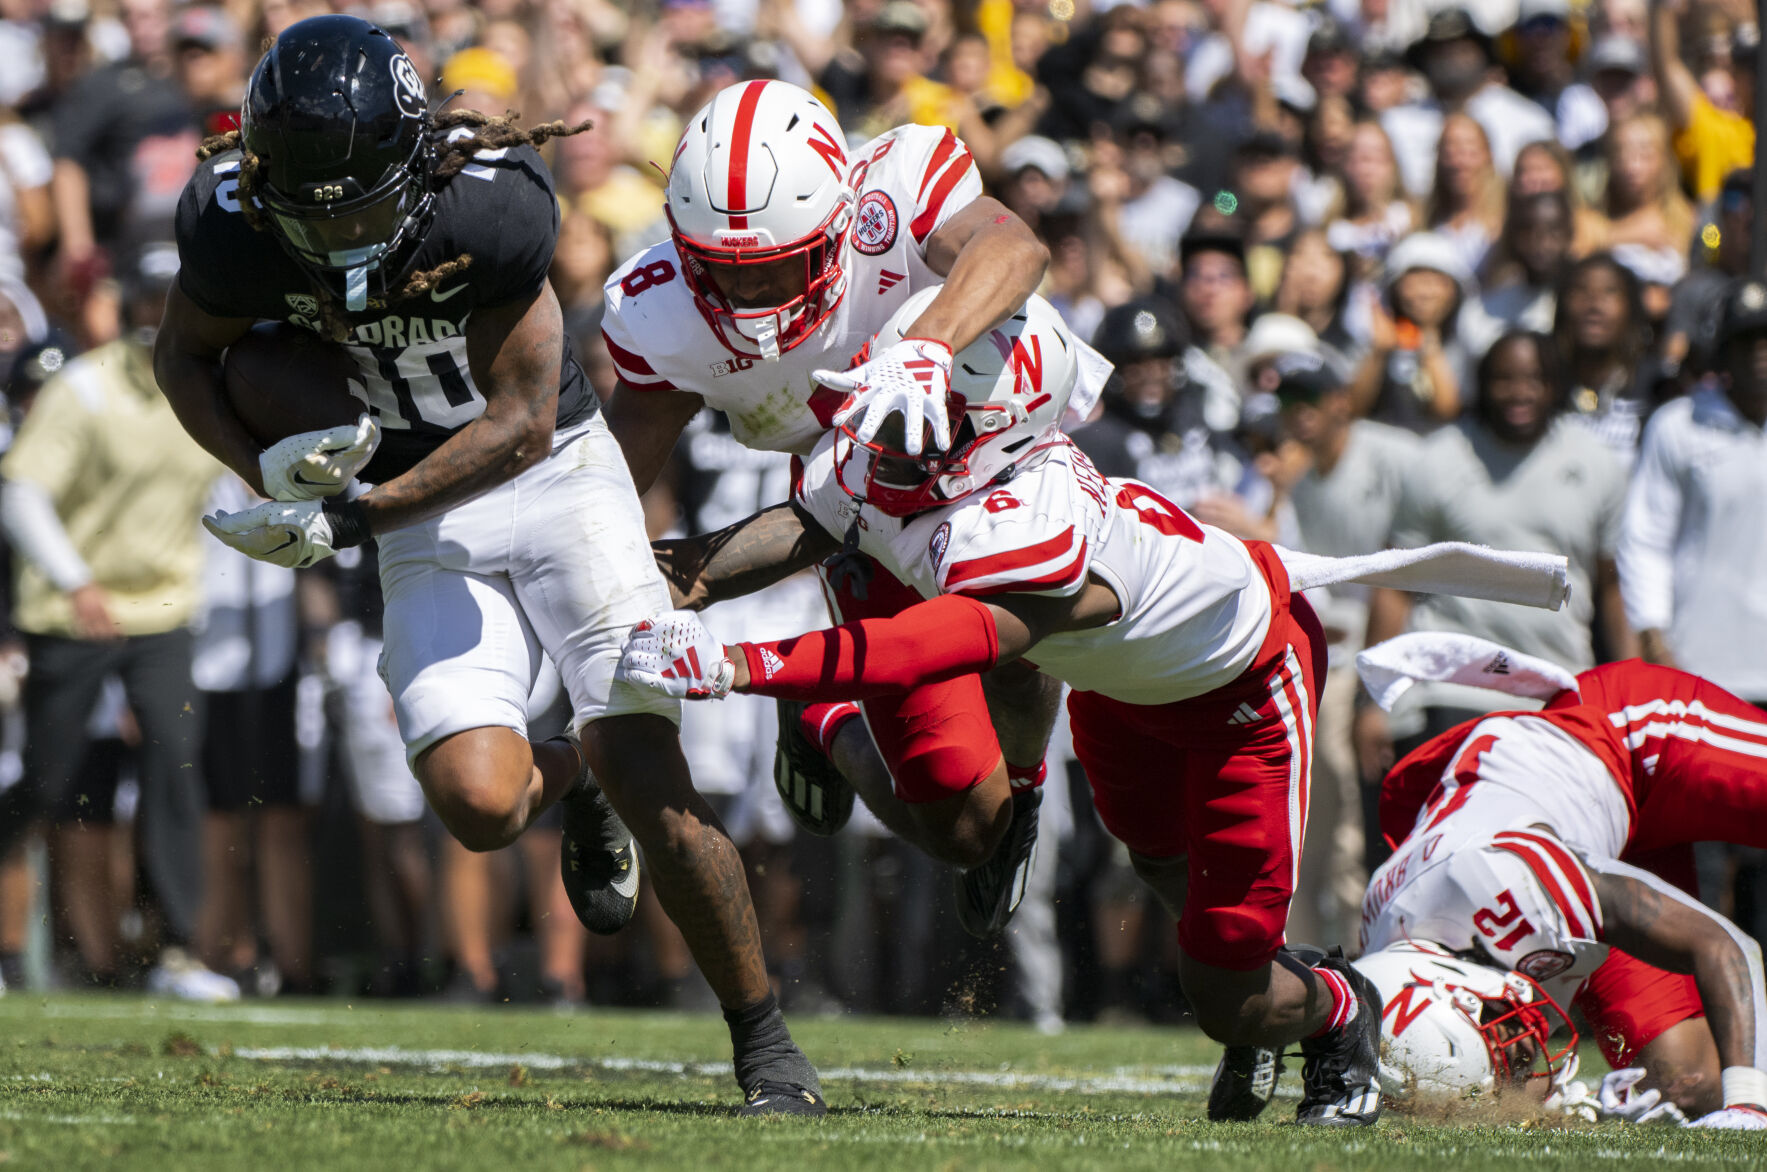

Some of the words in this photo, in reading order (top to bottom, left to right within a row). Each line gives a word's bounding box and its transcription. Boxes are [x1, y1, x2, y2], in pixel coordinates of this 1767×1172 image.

[807, 122, 848, 184] N
[720, 235, 759, 248] HUSKERS
[858, 209, 885, 237] HUSKERS
[620, 259, 677, 298] 8
[342, 336, 489, 431] 10
[1009, 334, 1043, 395] N
[983, 489, 1019, 514] 6
[760, 647, 774, 681] adidas
[1472, 887, 1537, 952] 12
[1382, 985, 1433, 1039] N
